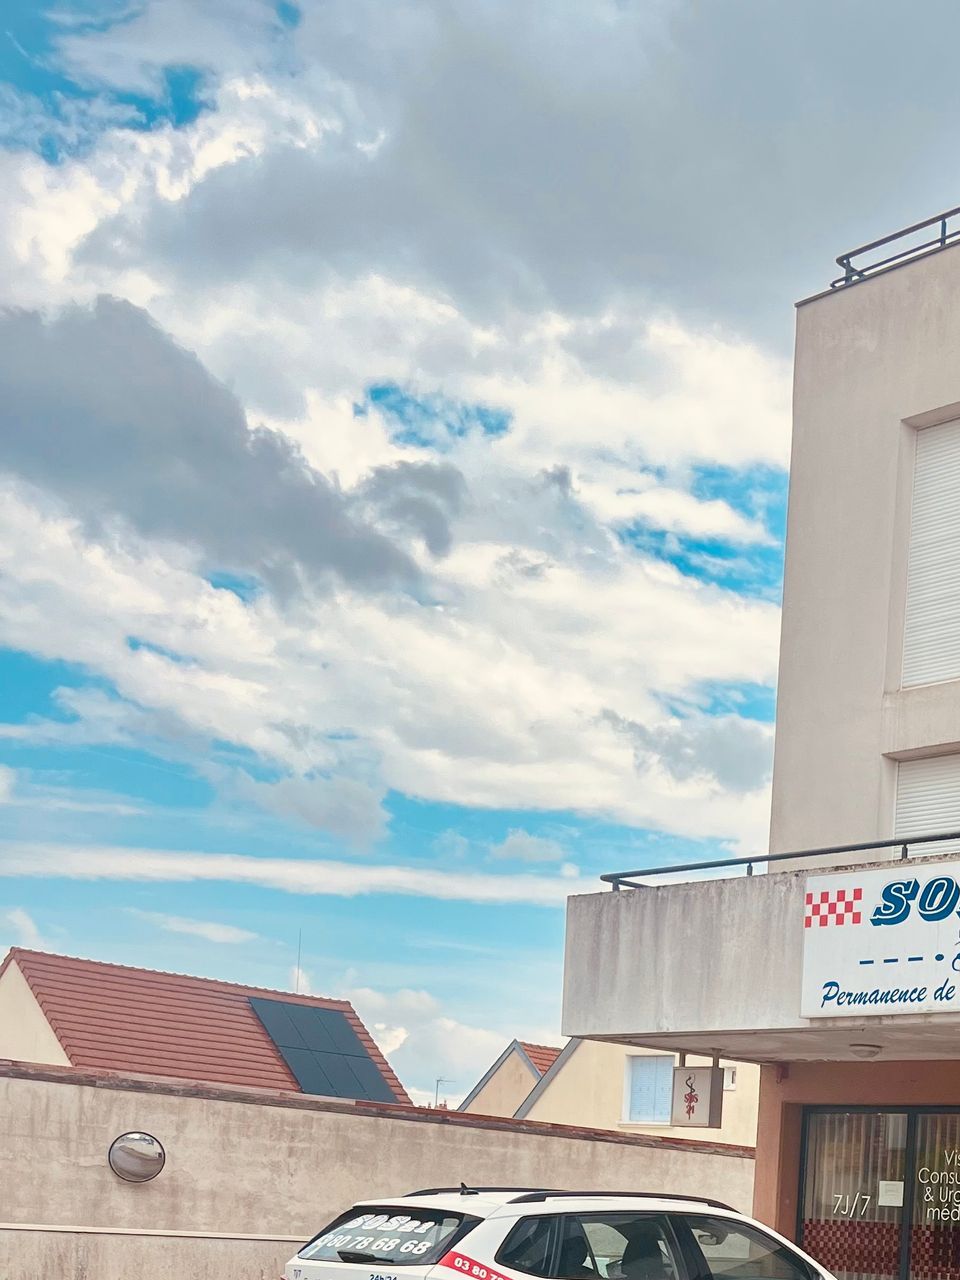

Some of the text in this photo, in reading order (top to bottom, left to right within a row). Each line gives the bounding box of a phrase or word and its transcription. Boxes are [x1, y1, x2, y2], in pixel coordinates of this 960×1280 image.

[821, 980, 927, 1008] Permanence
[934, 978, 955, 1000] de
[924, 1187, 935, 1202] &
[833, 1193, 871, 1217] 7J/7
[344, 1214, 412, 1231] SOS
[349, 1236, 374, 1249] 78
[371, 1238, 400, 1252] 68
[400, 1240, 433, 1255] 68
[454, 1257, 470, 1271] 03
[472, 1265, 487, 1279] 80
